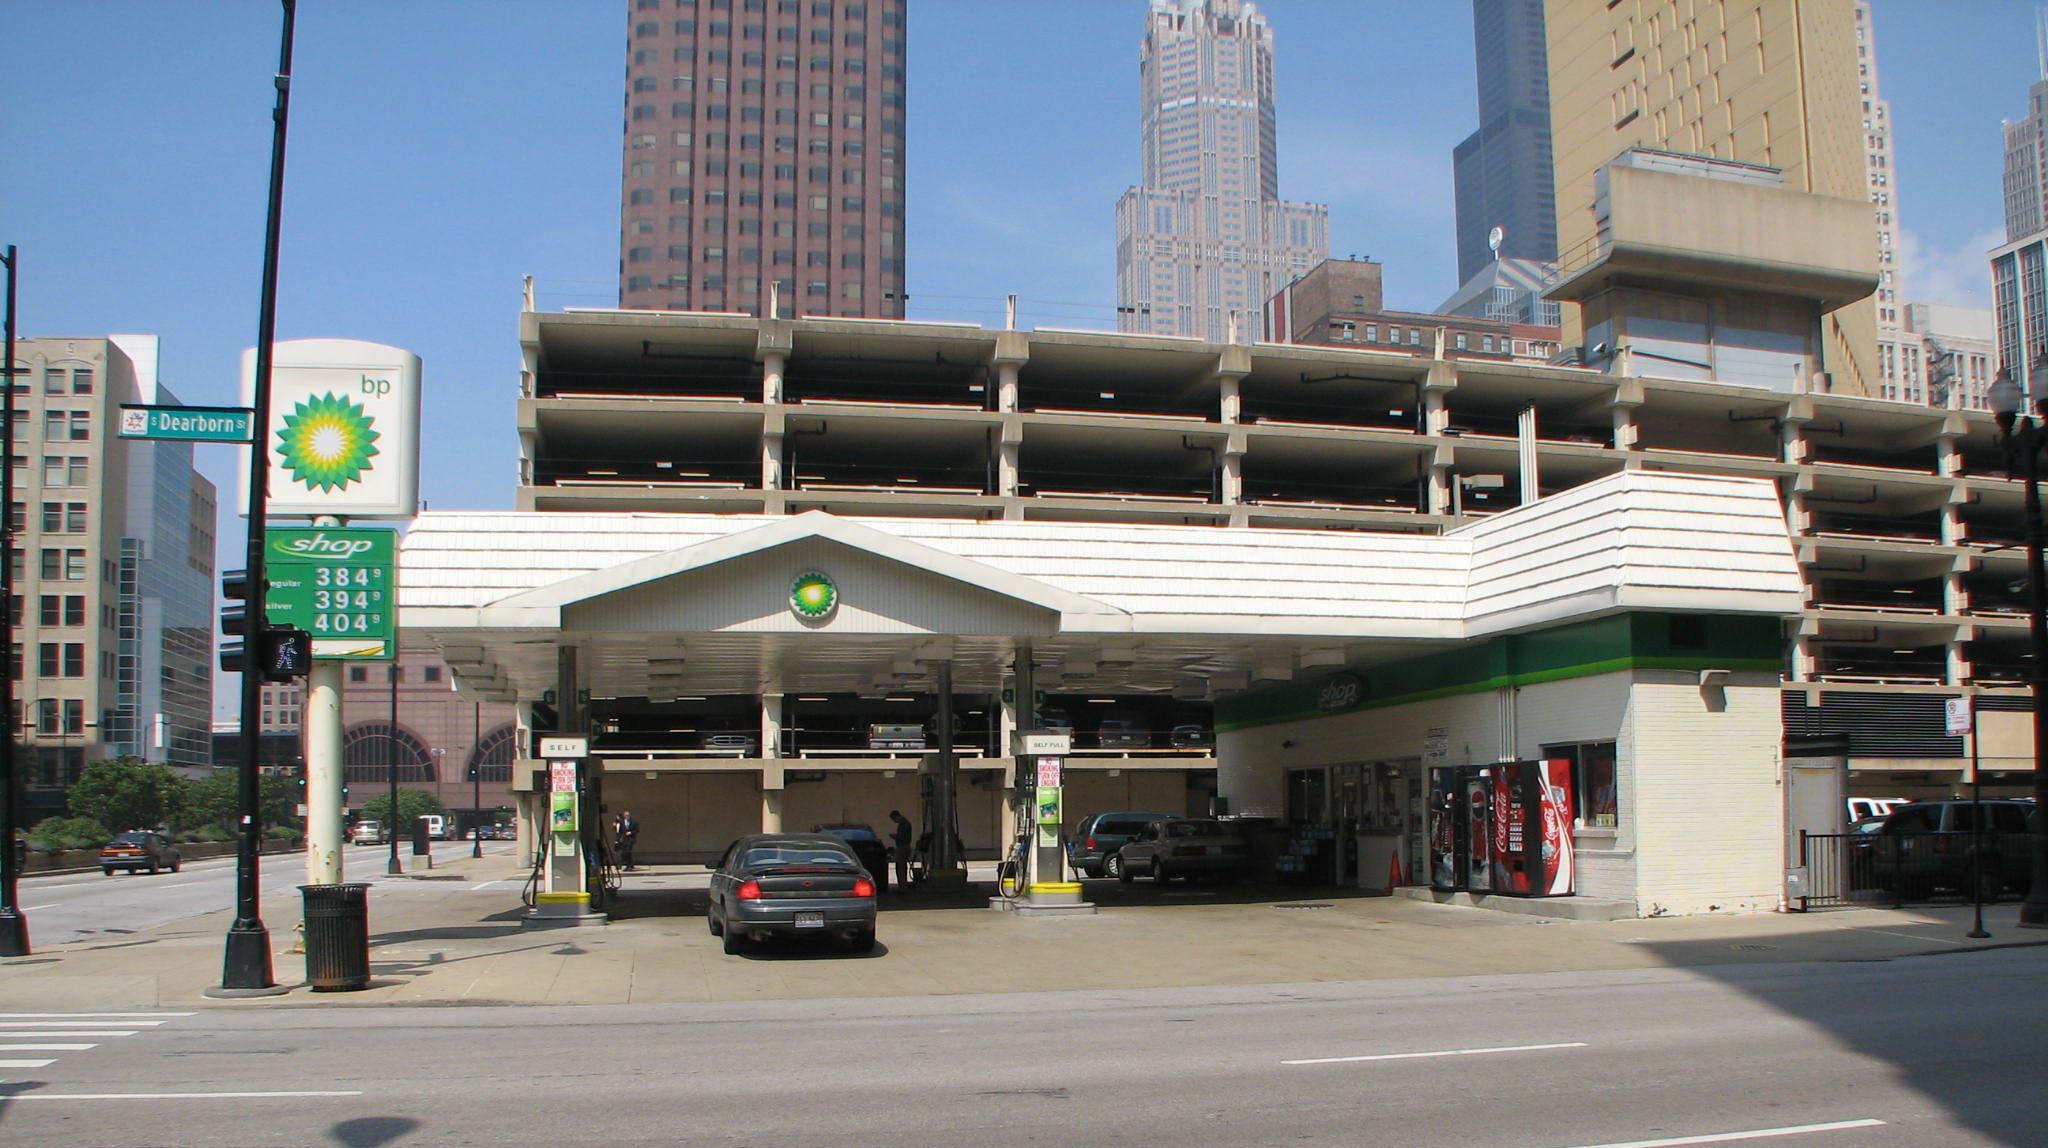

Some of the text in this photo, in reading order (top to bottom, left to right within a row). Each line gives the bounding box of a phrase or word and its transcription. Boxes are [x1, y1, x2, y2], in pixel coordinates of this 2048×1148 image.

[361, 374, 391, 400] bp
[151, 416, 158, 427] S
[160, 412, 235, 433] Dearborn
[292, 532, 373, 559] shop
[270, 579, 302, 591] egular
[1321, 680, 1356, 702] shop
[1495, 790, 1507, 853] Coca-Cola
